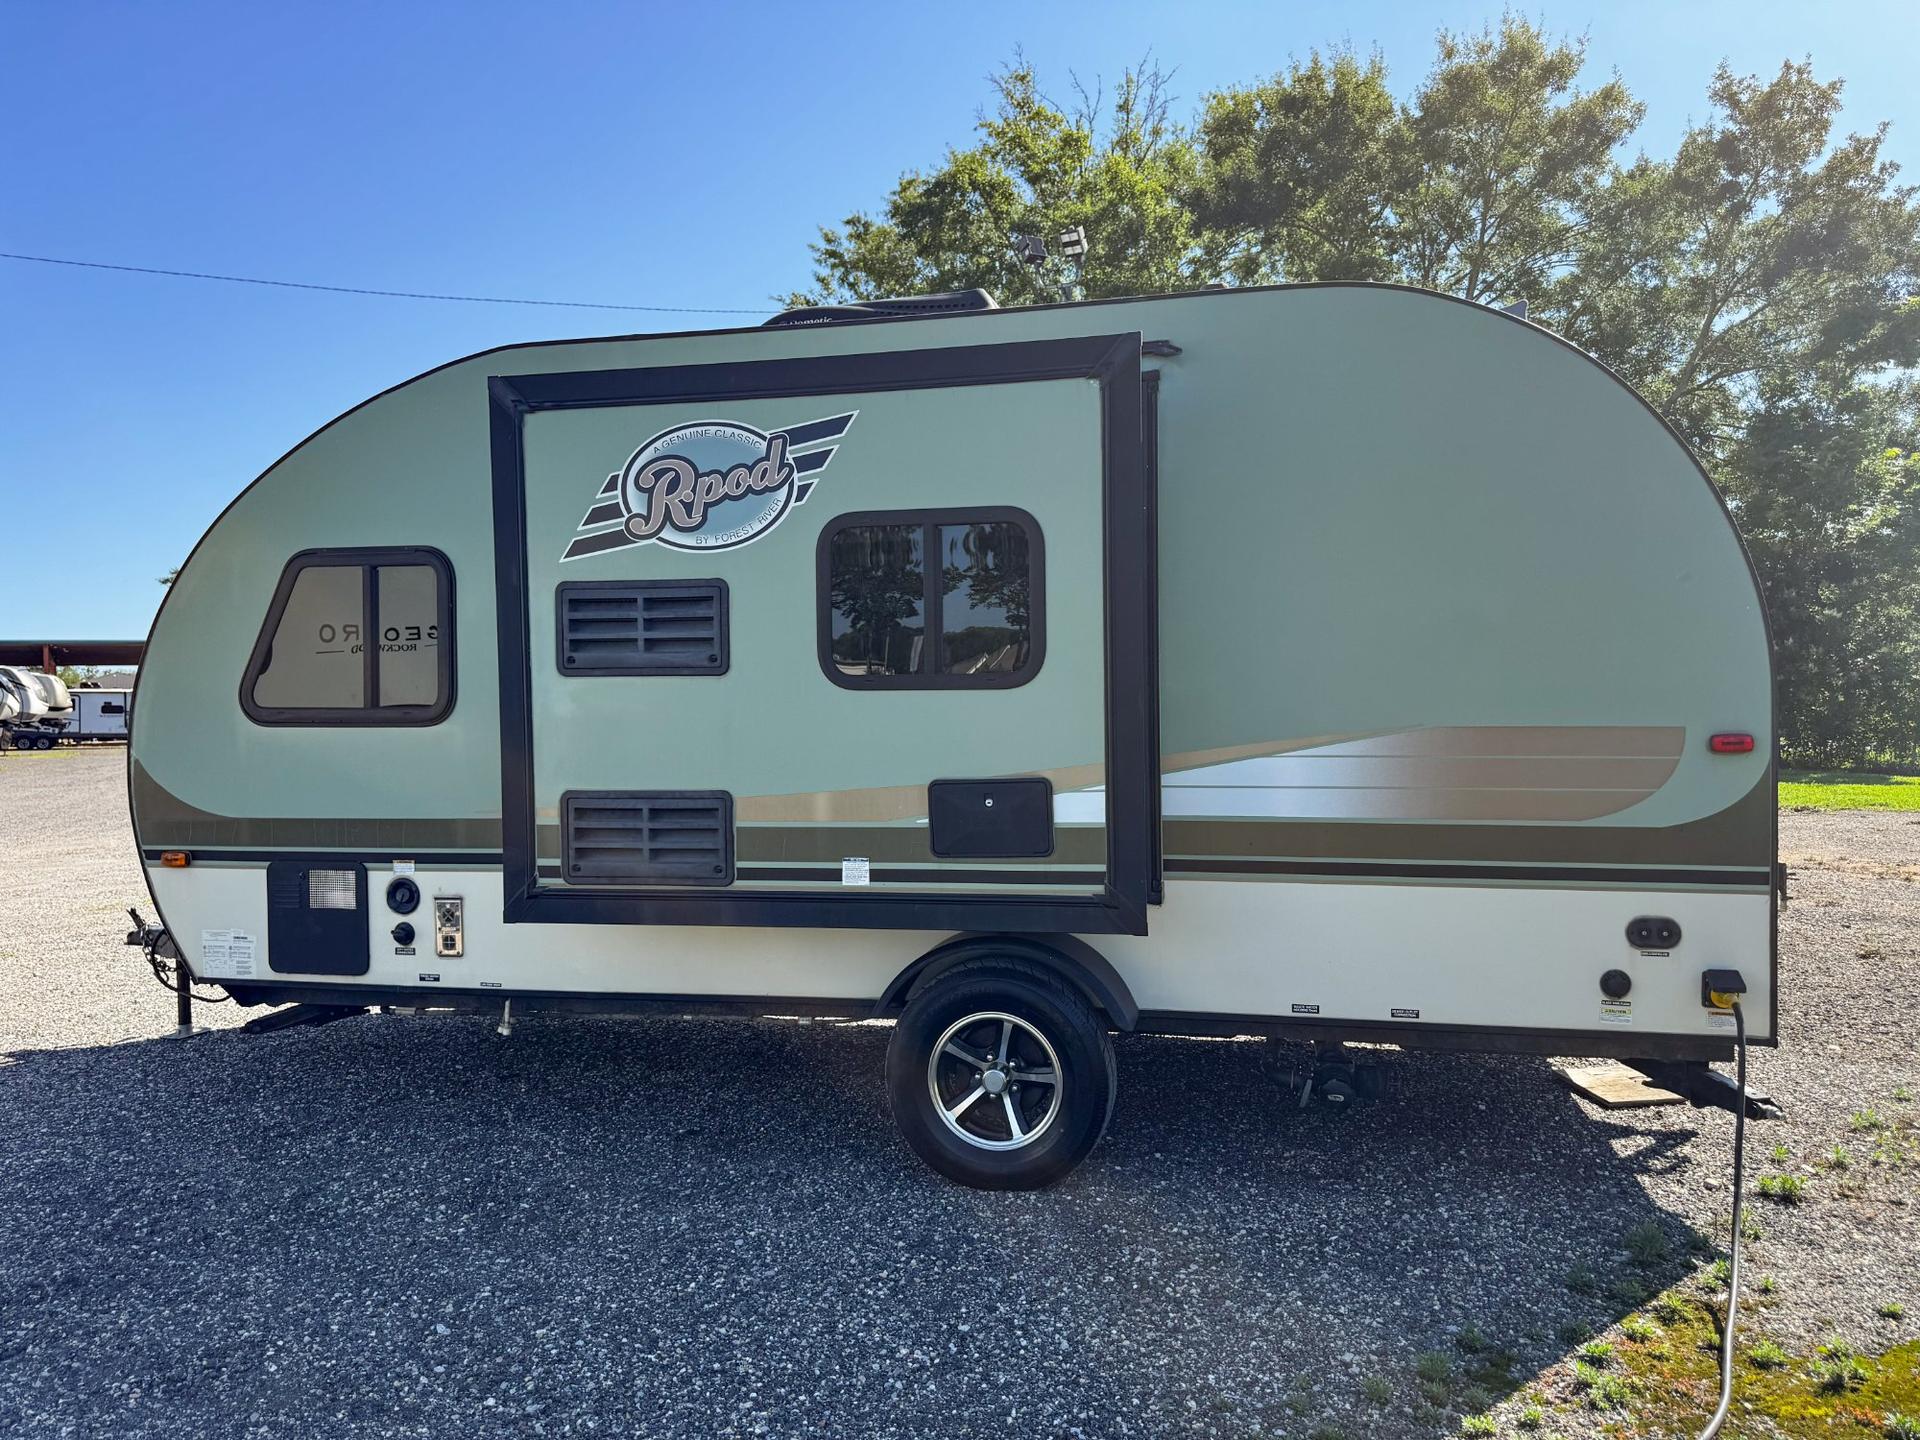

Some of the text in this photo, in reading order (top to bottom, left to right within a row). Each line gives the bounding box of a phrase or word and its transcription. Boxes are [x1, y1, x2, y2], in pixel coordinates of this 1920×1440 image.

[653, 429, 762, 454] A GENUINE CLASSIC
[695, 498, 782, 544] BY FOREST RIVER
